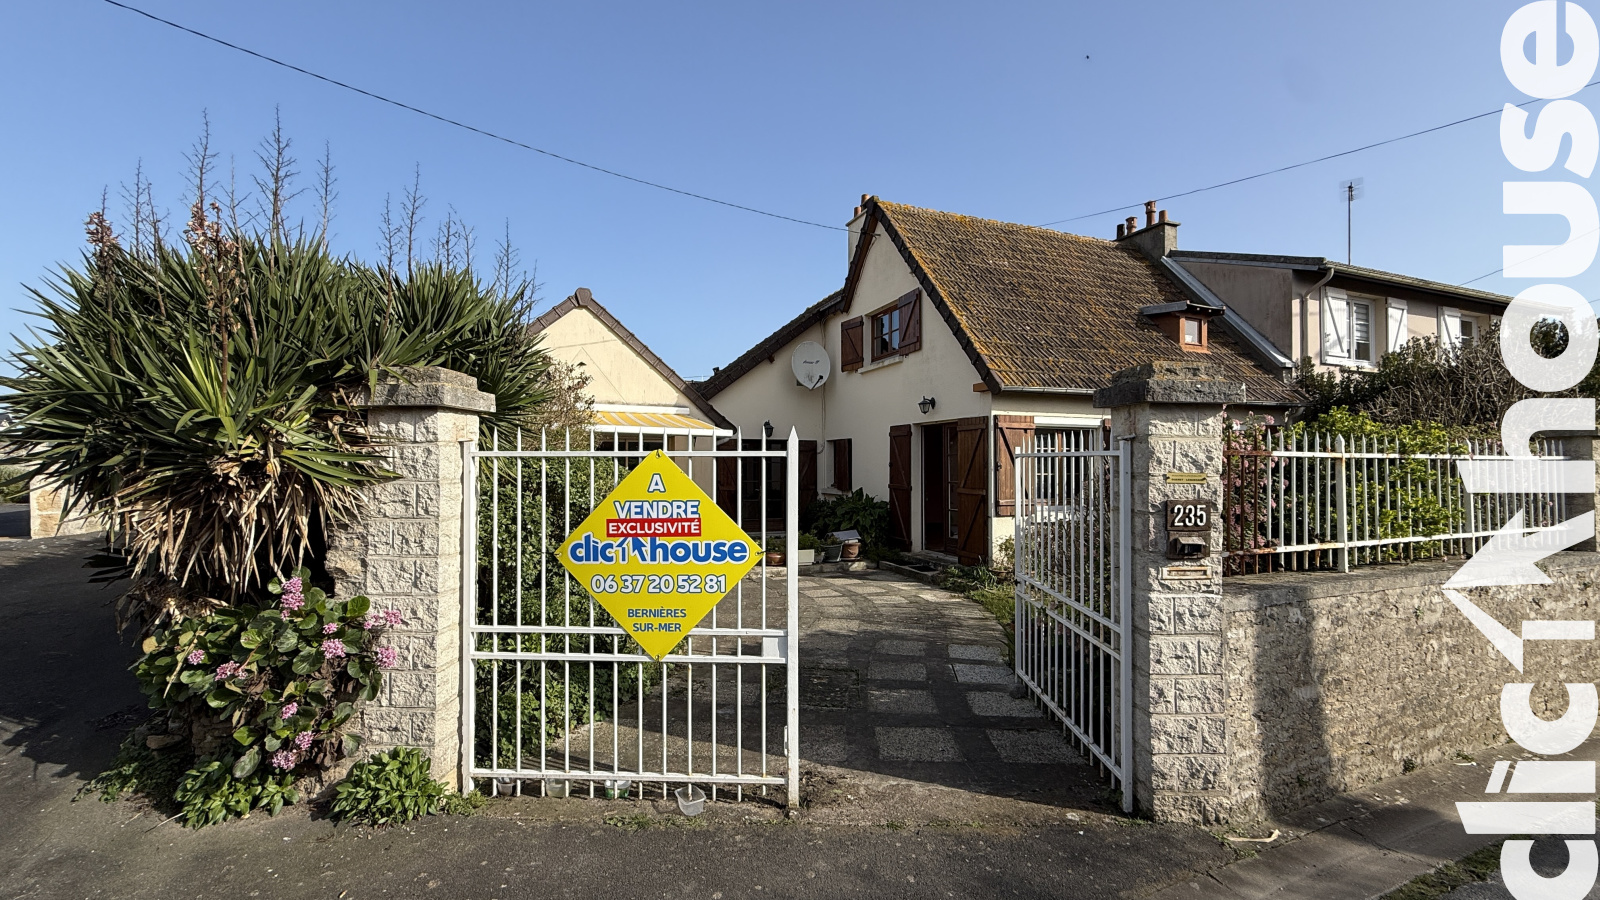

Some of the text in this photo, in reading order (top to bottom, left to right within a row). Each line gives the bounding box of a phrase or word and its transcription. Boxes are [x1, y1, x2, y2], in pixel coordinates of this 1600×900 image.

[647, 473, 666, 494] A
[614, 500, 700, 519] VENDRE
[1173, 504, 1207, 526] 235
[608, 519, 700, 535] EXCLUSIVITÉ
[591, 574, 726, 594] 06 37 20 52 81
[627, 605, 687, 618] BERNIÈRES
[632, 623, 682, 632] SUR-MER
